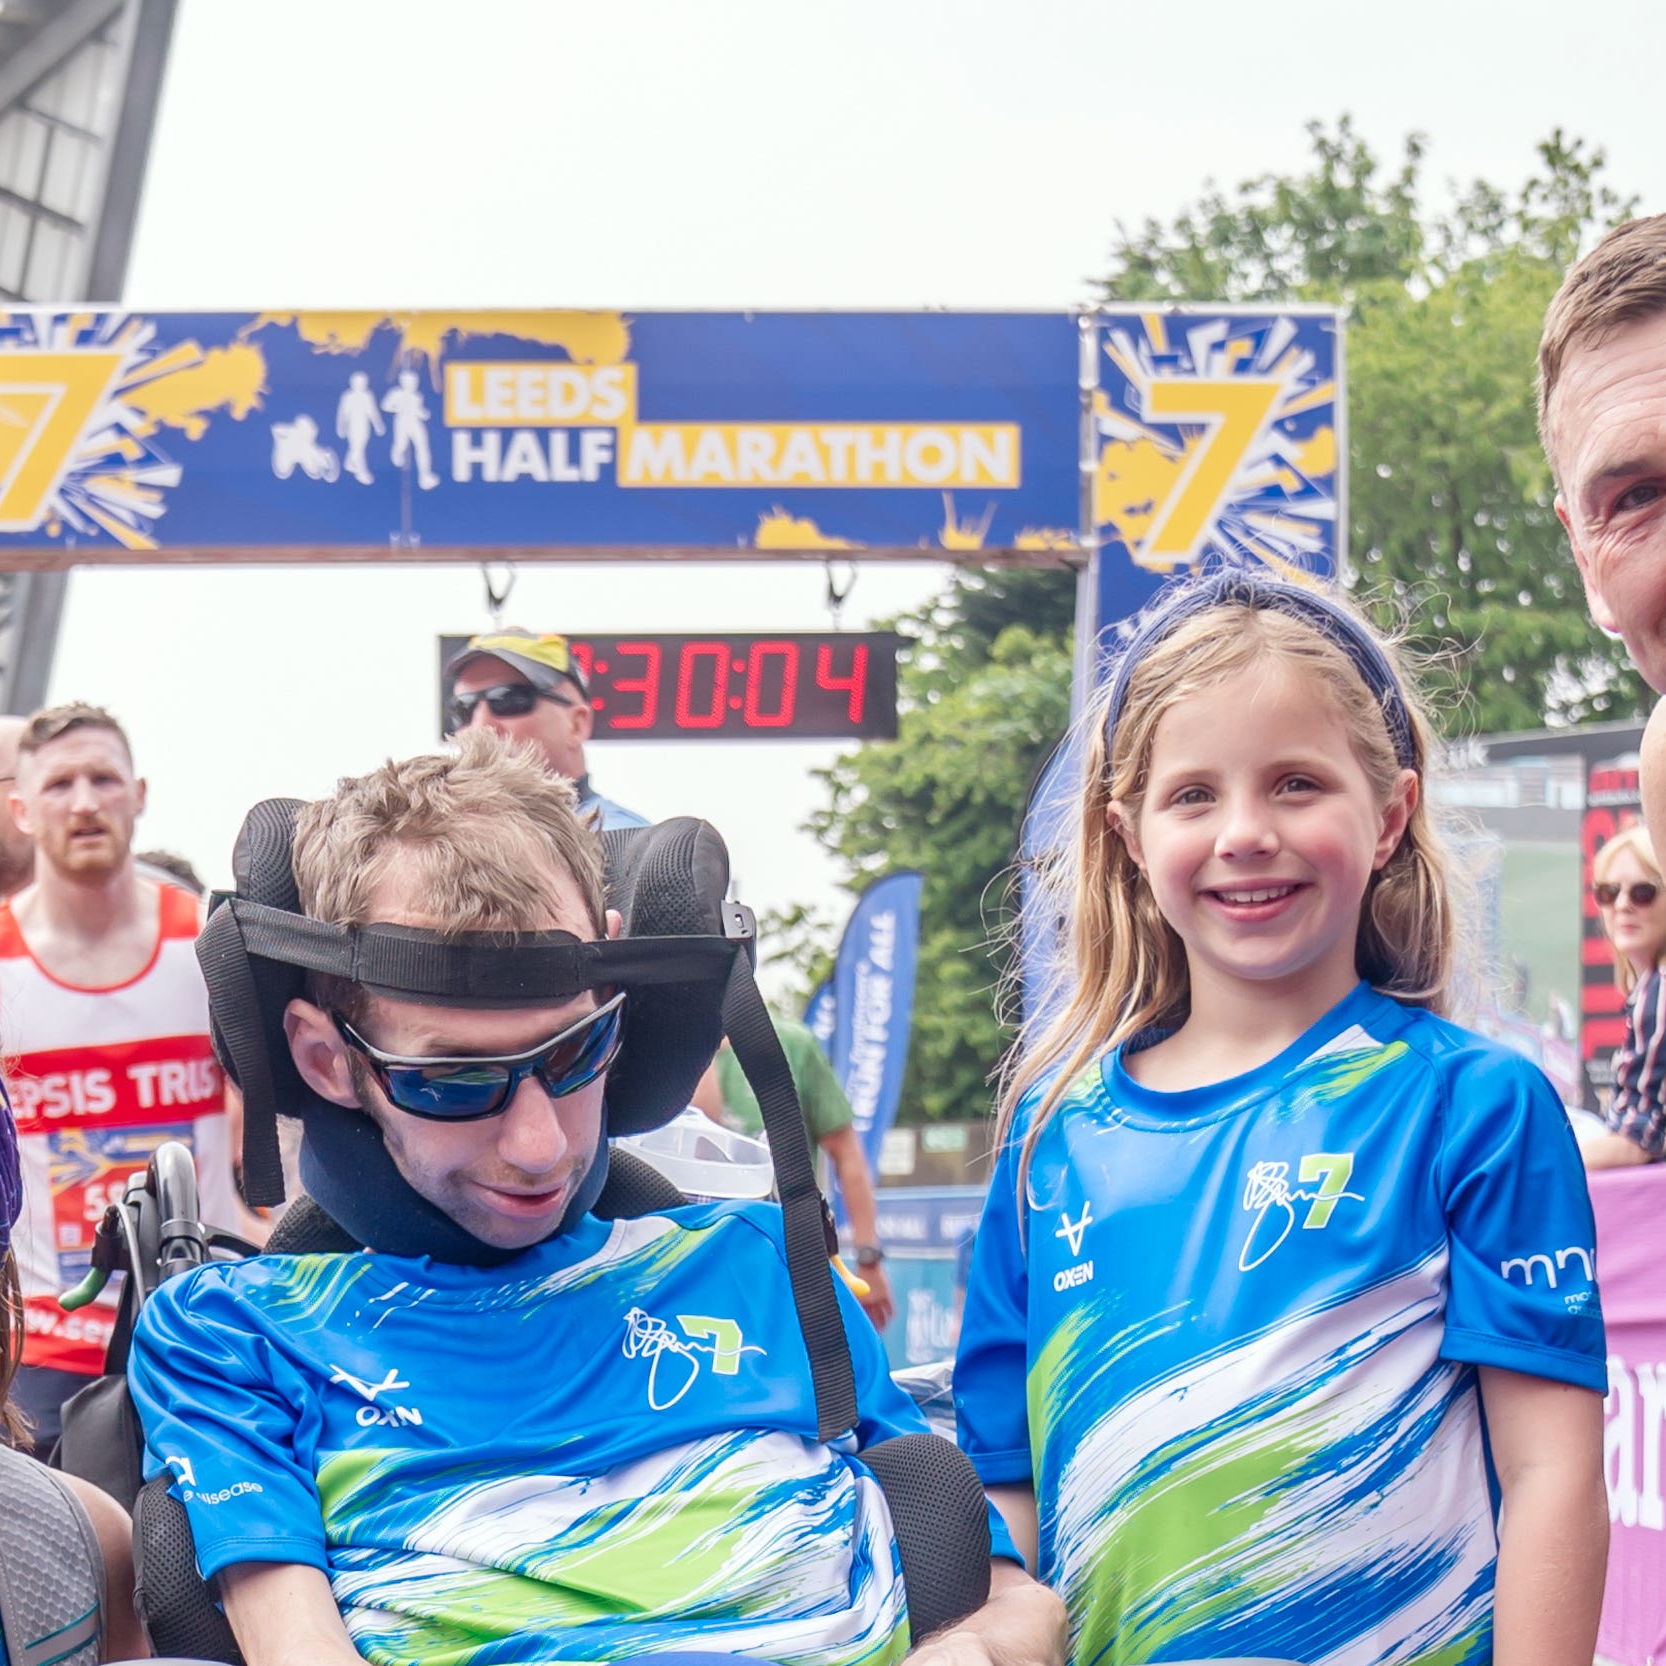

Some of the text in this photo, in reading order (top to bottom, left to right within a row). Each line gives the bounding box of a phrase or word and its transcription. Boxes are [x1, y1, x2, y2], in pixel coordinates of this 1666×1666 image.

[452, 367, 629, 420] LEEDS
[452, 430, 1012, 483] HALF MARATHON
[1136, 377, 1284, 563] 7
[10, 1057, 221, 1119] EPSIS TRUS
[1298, 1152, 1354, 1229] 7
[1053, 1260, 1094, 1292] OXEN
[1501, 1246, 1595, 1289] mn
[676, 1315, 743, 1375] 7
